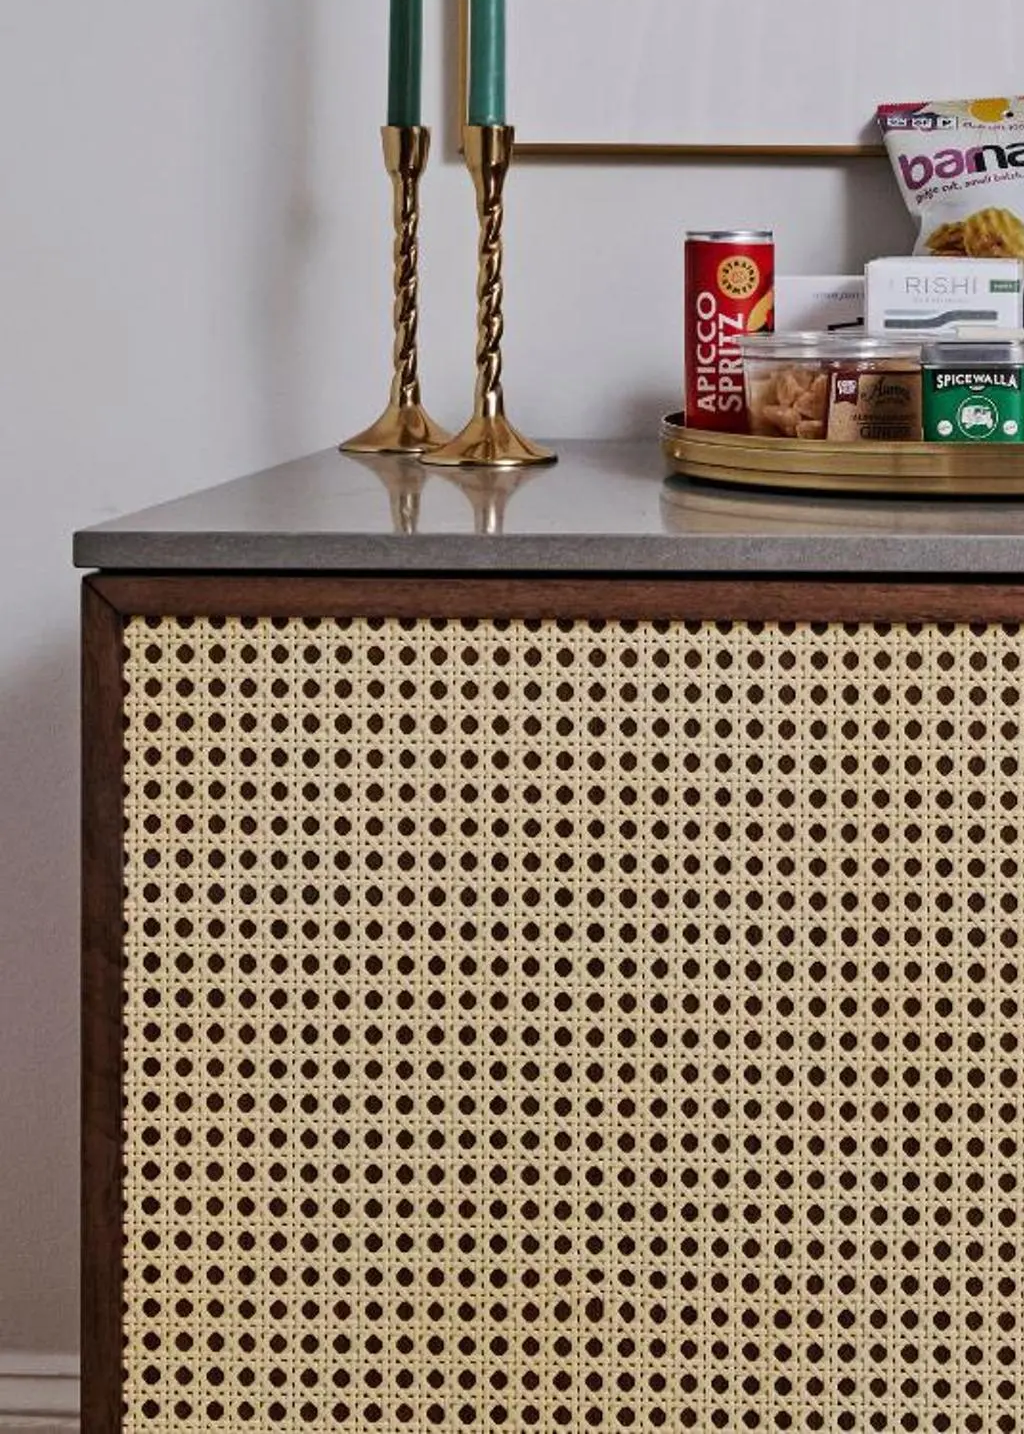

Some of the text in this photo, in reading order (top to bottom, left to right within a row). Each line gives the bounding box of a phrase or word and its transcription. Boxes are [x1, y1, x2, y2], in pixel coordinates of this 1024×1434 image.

[905, 276, 979, 295] RISHI
[696, 291, 717, 413] APICCO
[718, 313, 744, 413] SPRITZ
[936, 373, 1018, 390] SPICEWALLA
